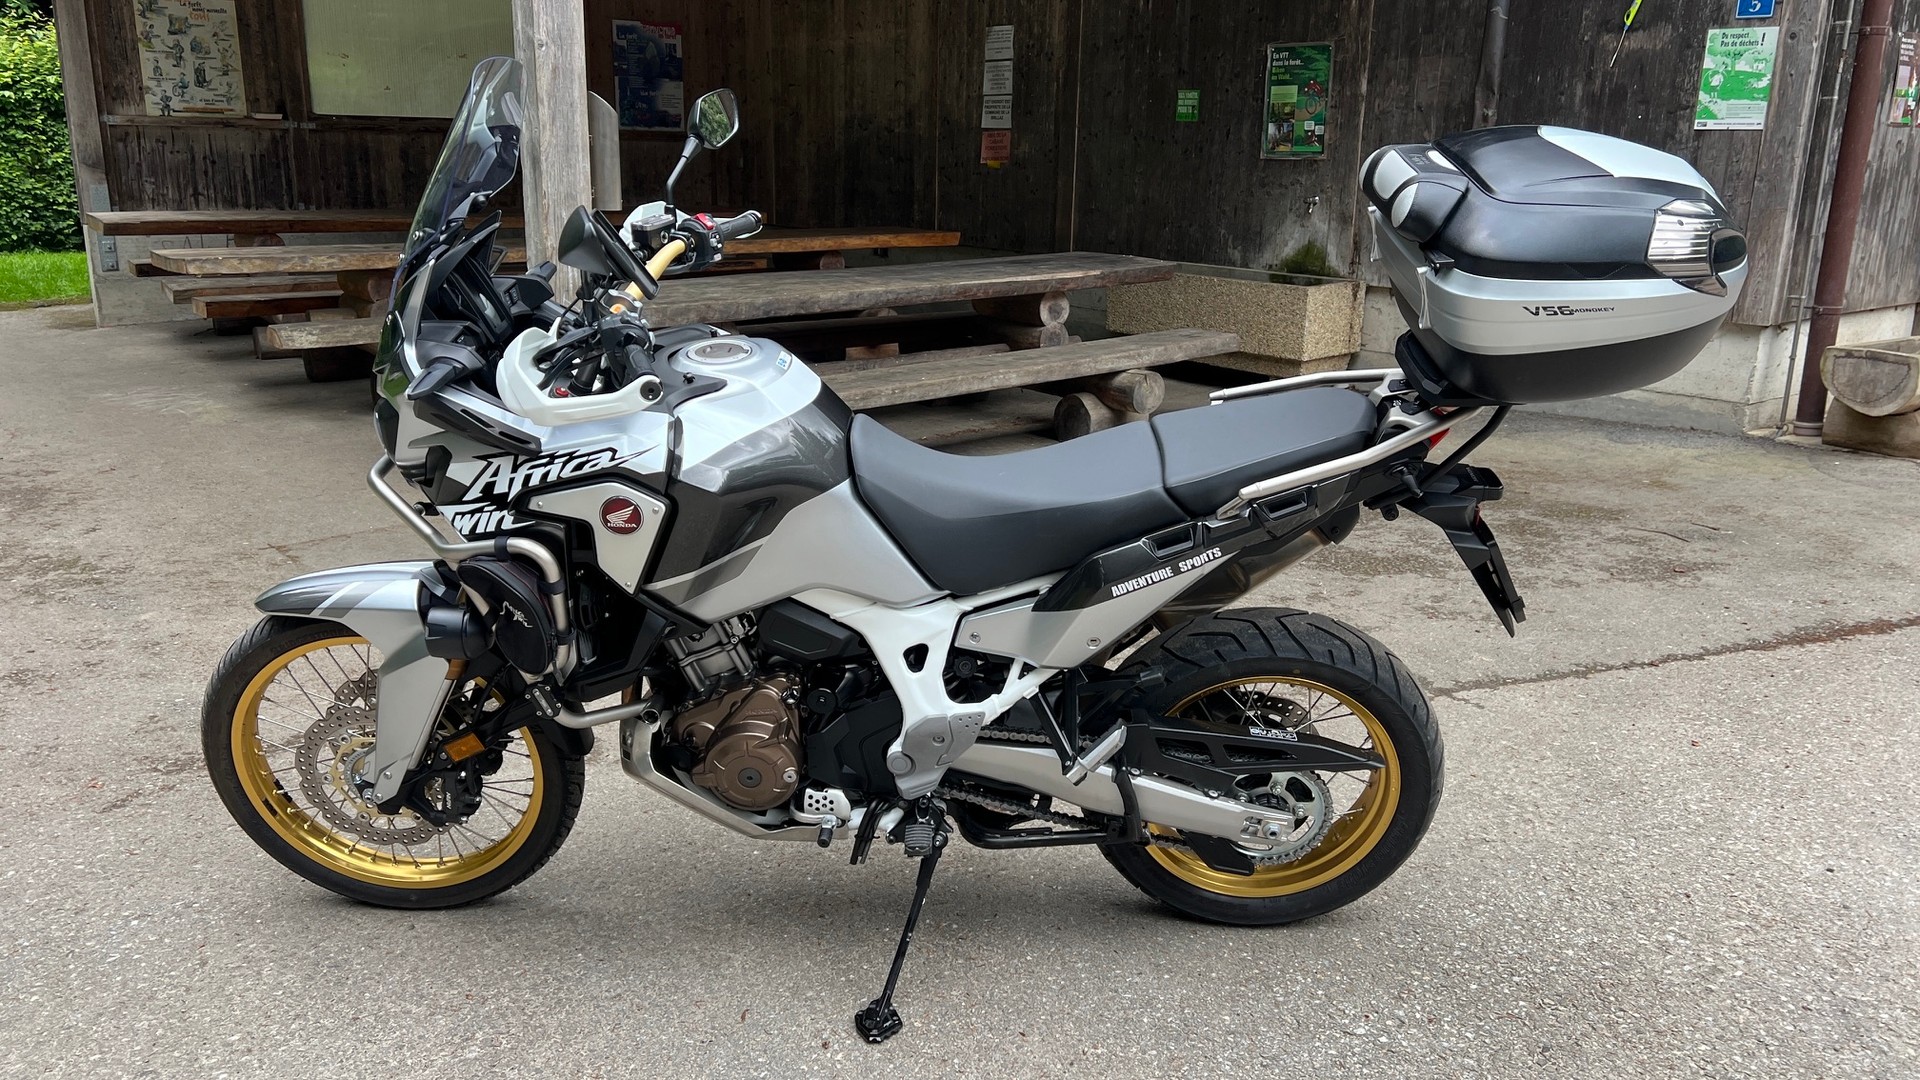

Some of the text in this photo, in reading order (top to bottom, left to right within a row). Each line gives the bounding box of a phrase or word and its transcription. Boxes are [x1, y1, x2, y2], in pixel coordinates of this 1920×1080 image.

[1749, 0, 1761, 12] 5
[1721, 32, 1750, 40] Du respect
[1522, 305, 1615, 316] V56 MONOKEY
[462, 444, 659, 502] Africa
[437, 502, 535, 535] Twin
[1111, 547, 1222, 597] ADVENTURE SPORTS
